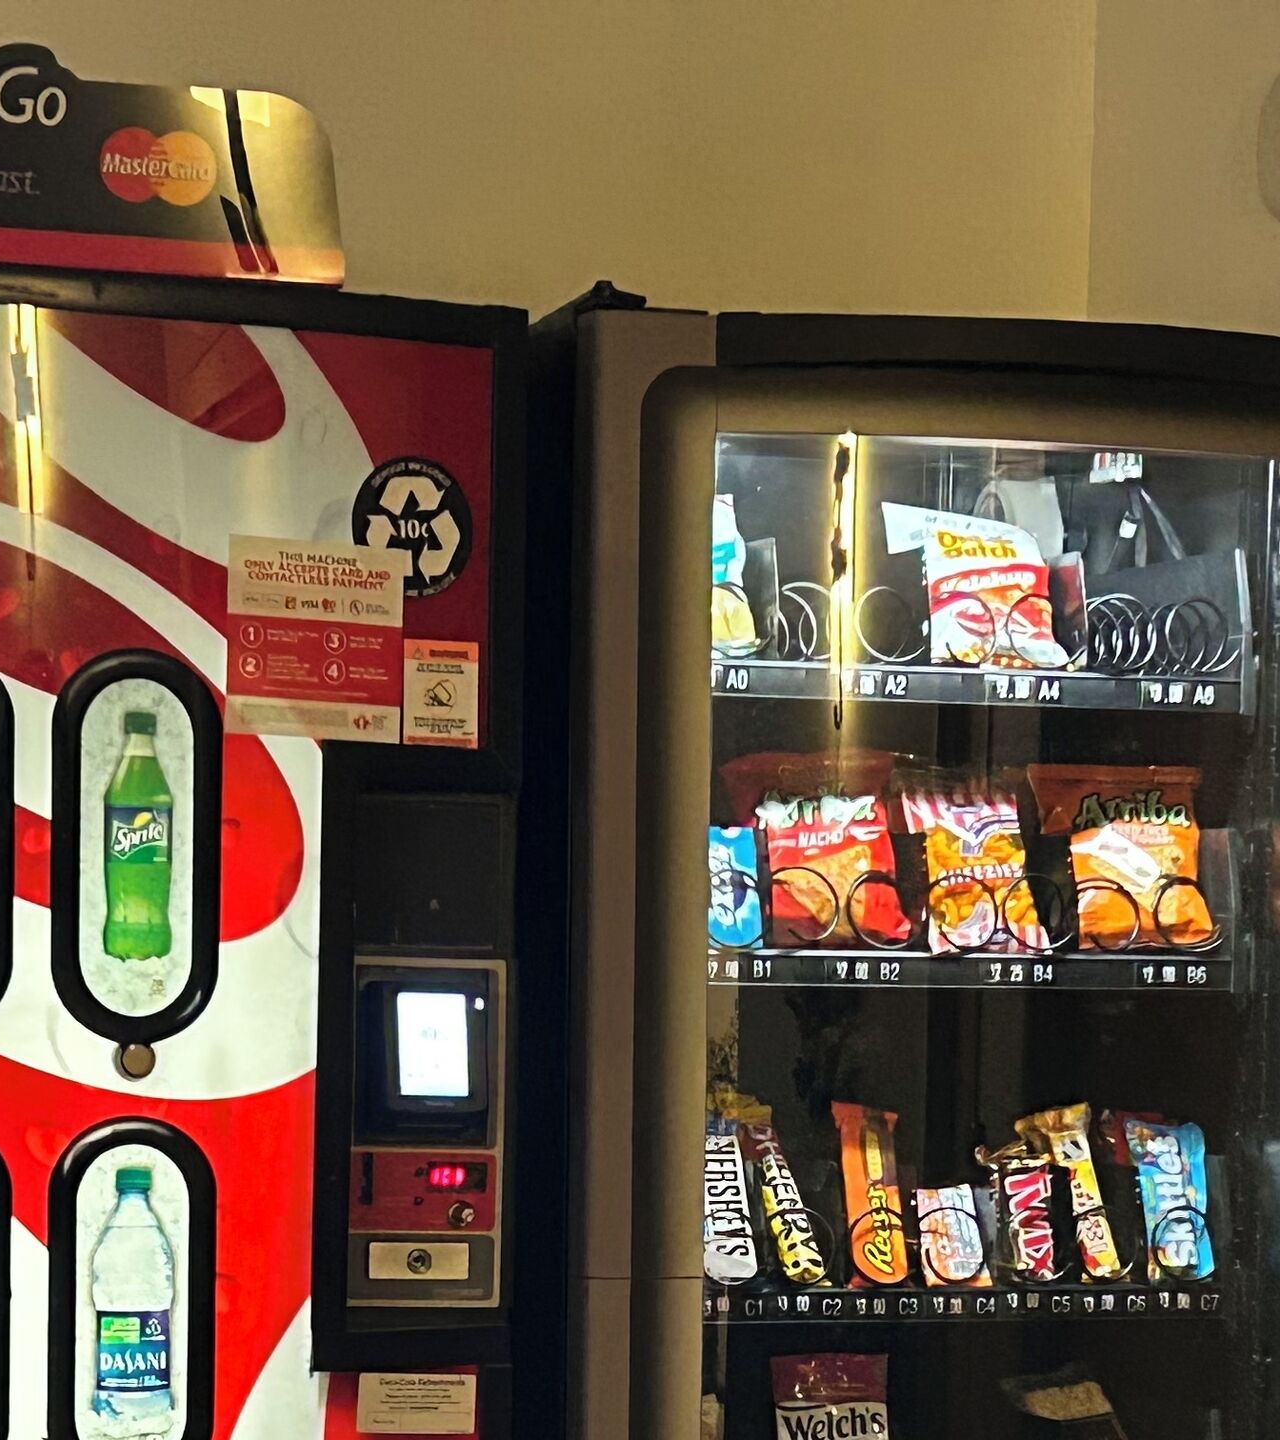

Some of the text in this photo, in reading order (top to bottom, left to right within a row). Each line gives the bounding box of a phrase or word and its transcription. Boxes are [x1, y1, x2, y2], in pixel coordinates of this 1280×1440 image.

[279, 563, 329, 576] ACCEPTS
[333, 567, 363, 578] CARD
[248, 571, 385, 590] CONTACTLESS PAYMENT
[329, 633, 339, 648] 3
[245, 657, 256, 672] 2
[328, 663, 338, 679] 4
[726, 668, 749, 690] A0
[885, 674, 907, 696] A2
[1038, 680, 1061, 700] A4
[1074, 790, 1191, 829] Arriba
[113, 822, 163, 852] Sprite
[798, 832, 844, 848] NACHO
[754, 960, 771, 978] B1
[880, 962, 901, 981] B2
[1033, 964, 1053, 982] B4
[745, 1299, 763, 1316] C1
[822, 1298, 842, 1316] C2
[899, 1297, 918, 1315] C3
[977, 1297, 995, 1314] C4
[1051, 1296, 1071, 1313] C5
[1127, 1295, 1146, 1312] C6
[1200, 1294, 1219, 1311] C7
[100, 1348, 167, 1374] DASANI
